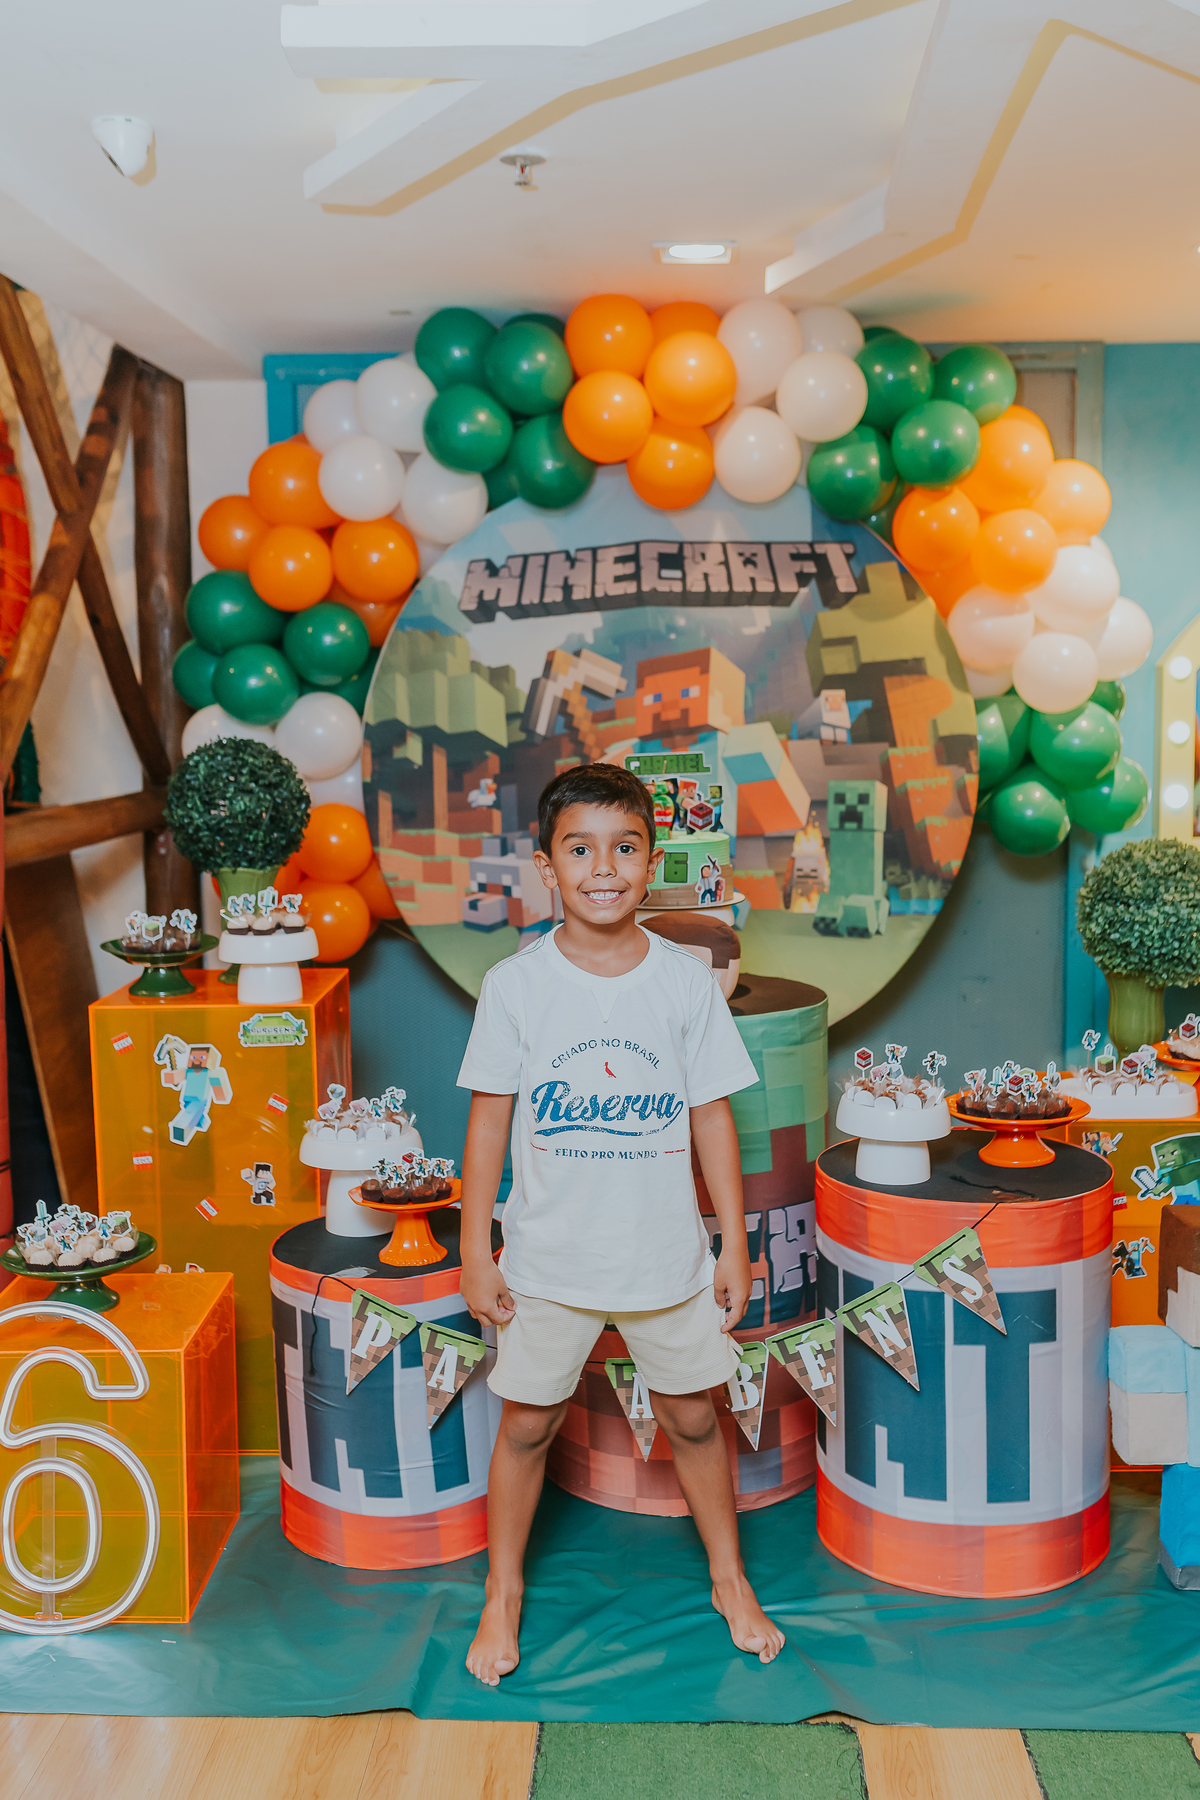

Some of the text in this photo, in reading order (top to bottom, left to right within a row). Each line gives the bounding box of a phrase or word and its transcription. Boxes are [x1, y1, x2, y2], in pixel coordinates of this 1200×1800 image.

[457, 539, 861, 625] MINECRAFT
[625, 753, 711, 775] GABRIEL
[551, 1038, 661, 1070] CRIADO NO BRASIL
[530, 1080, 684, 1128] Reserva
[555, 1148, 658, 1160] FEITO PRO MUNDO
[0, 1301, 160, 1636] 6
